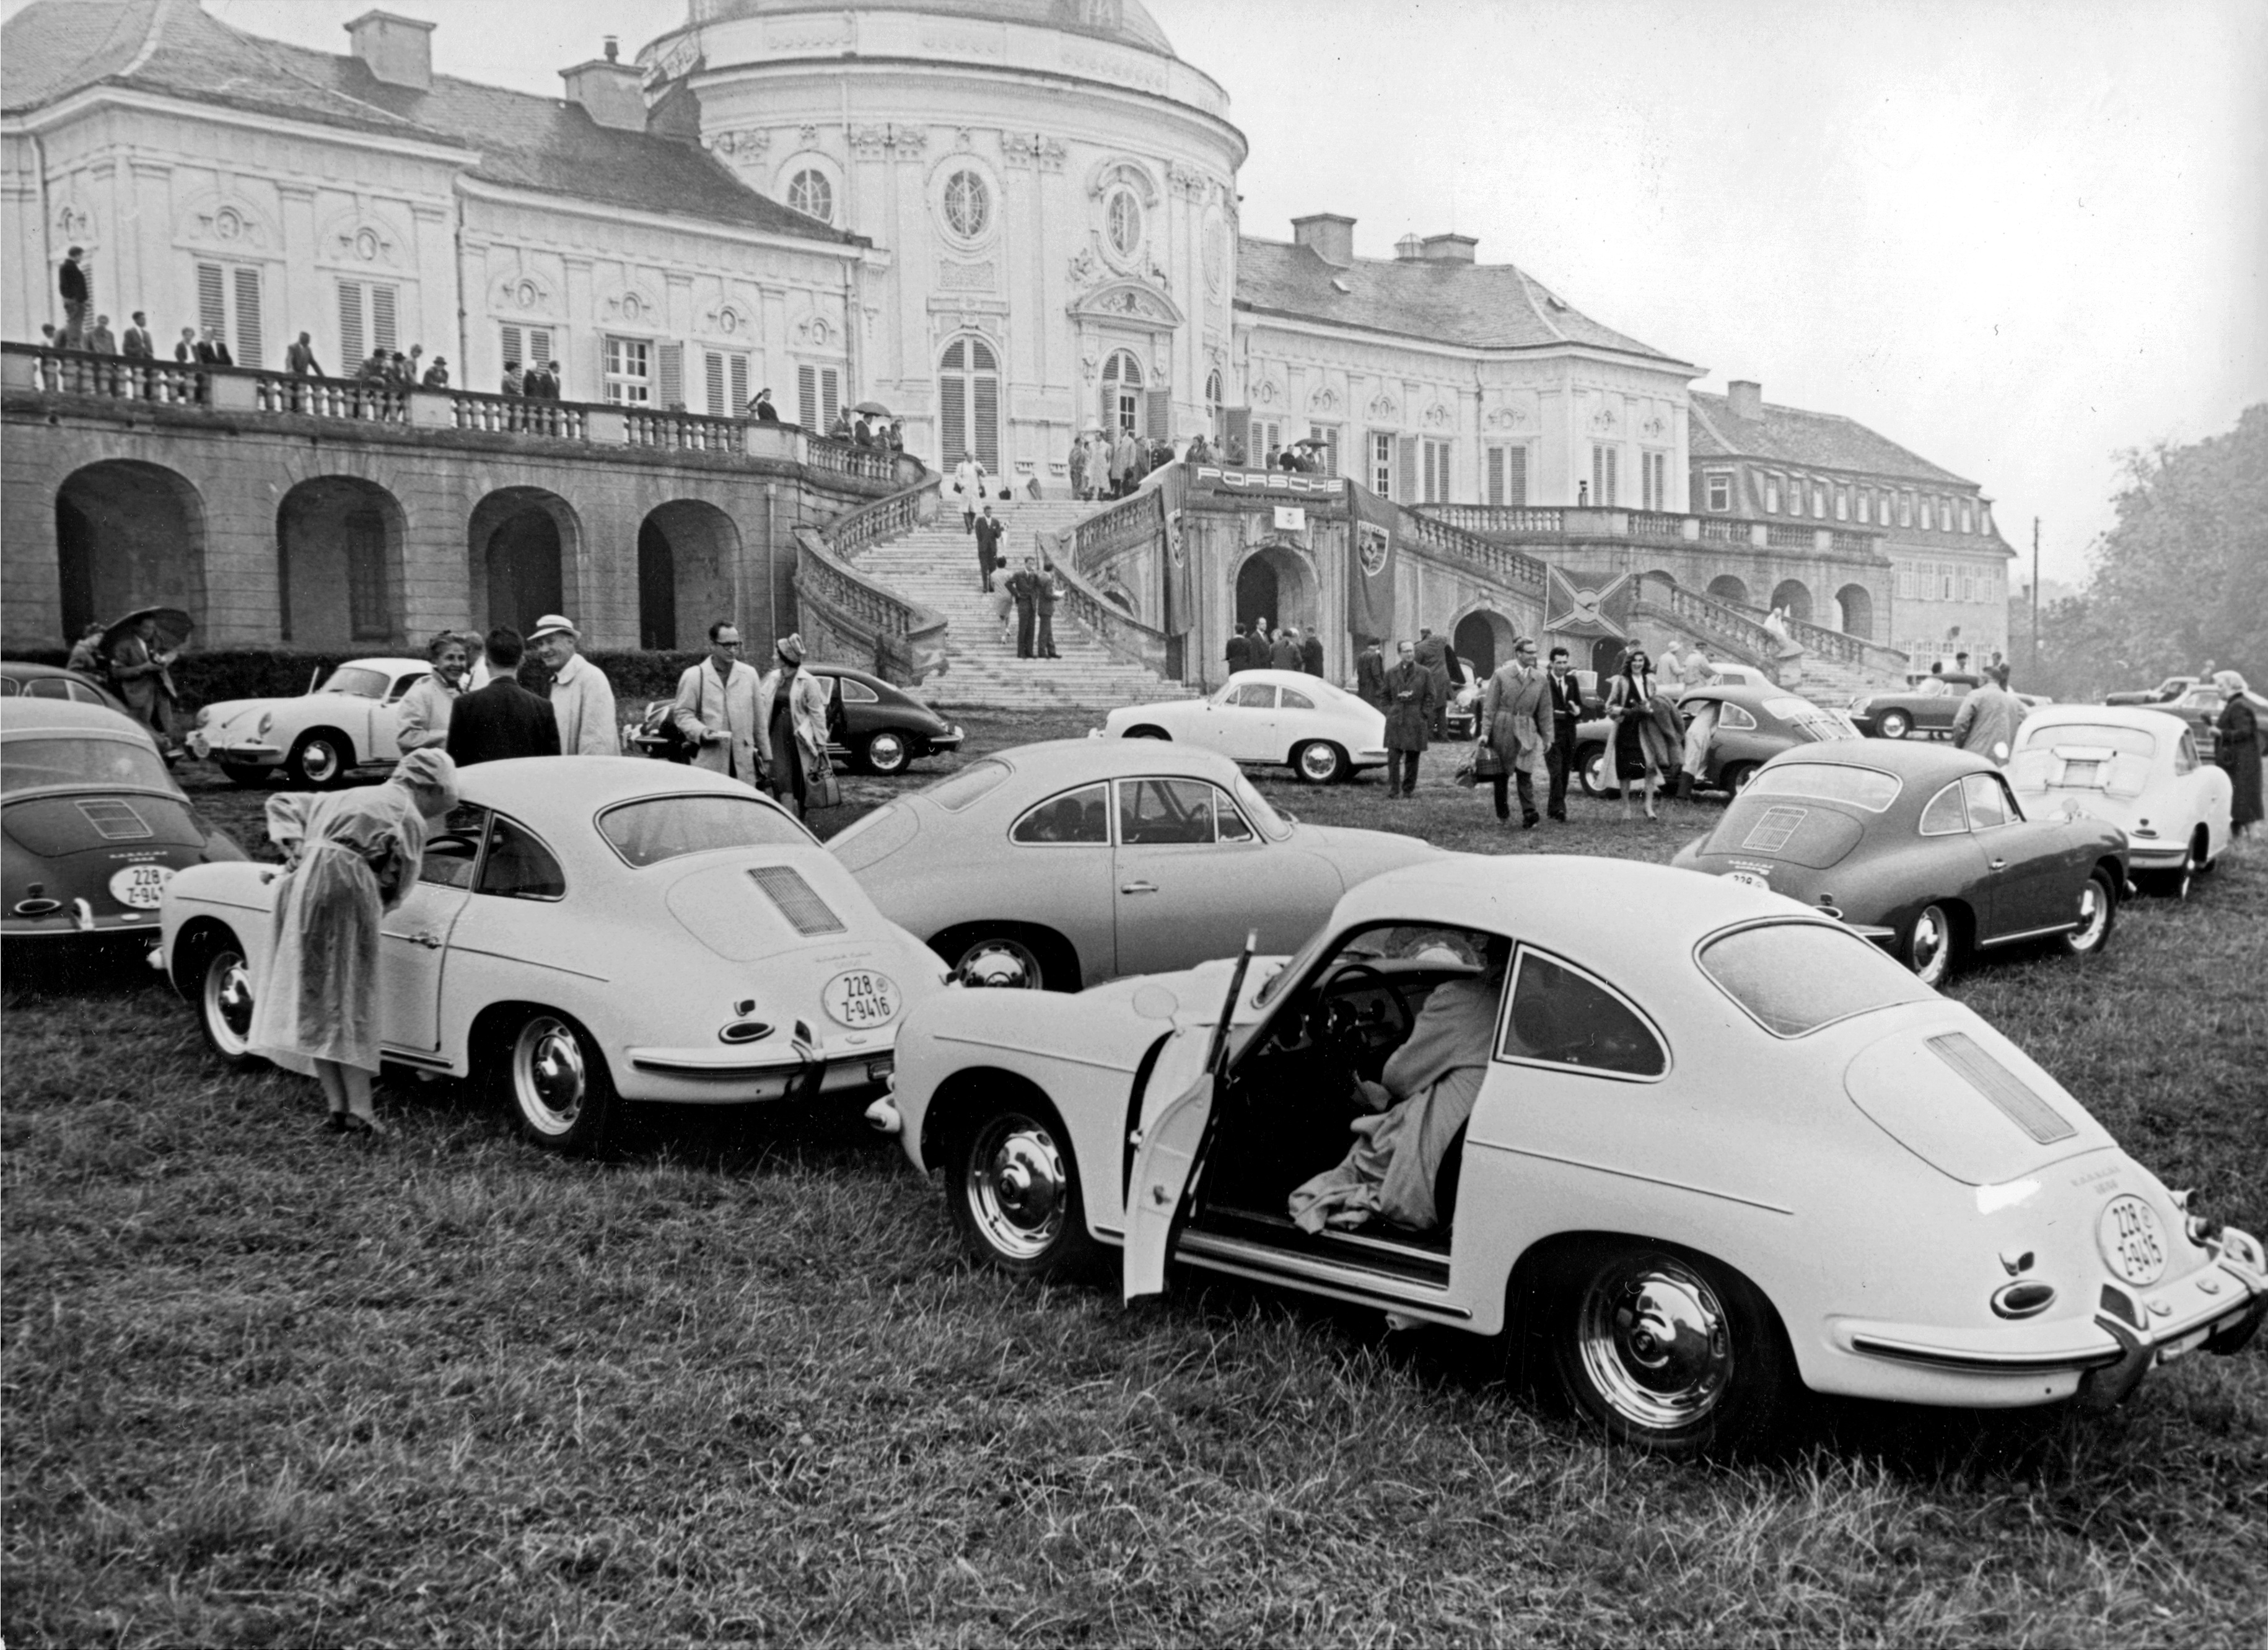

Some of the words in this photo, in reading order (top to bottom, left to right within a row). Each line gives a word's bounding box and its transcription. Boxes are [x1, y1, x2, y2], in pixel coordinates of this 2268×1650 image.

[1197, 467, 1343, 493] PORSCHE
[133, 869, 161, 885] 228
[844, 975, 873, 998] 228
[841, 996, 891, 1022] Z-9416
[2113, 1203, 2142, 1239] 228
[2117, 1234, 2163, 1277] Z-9415
